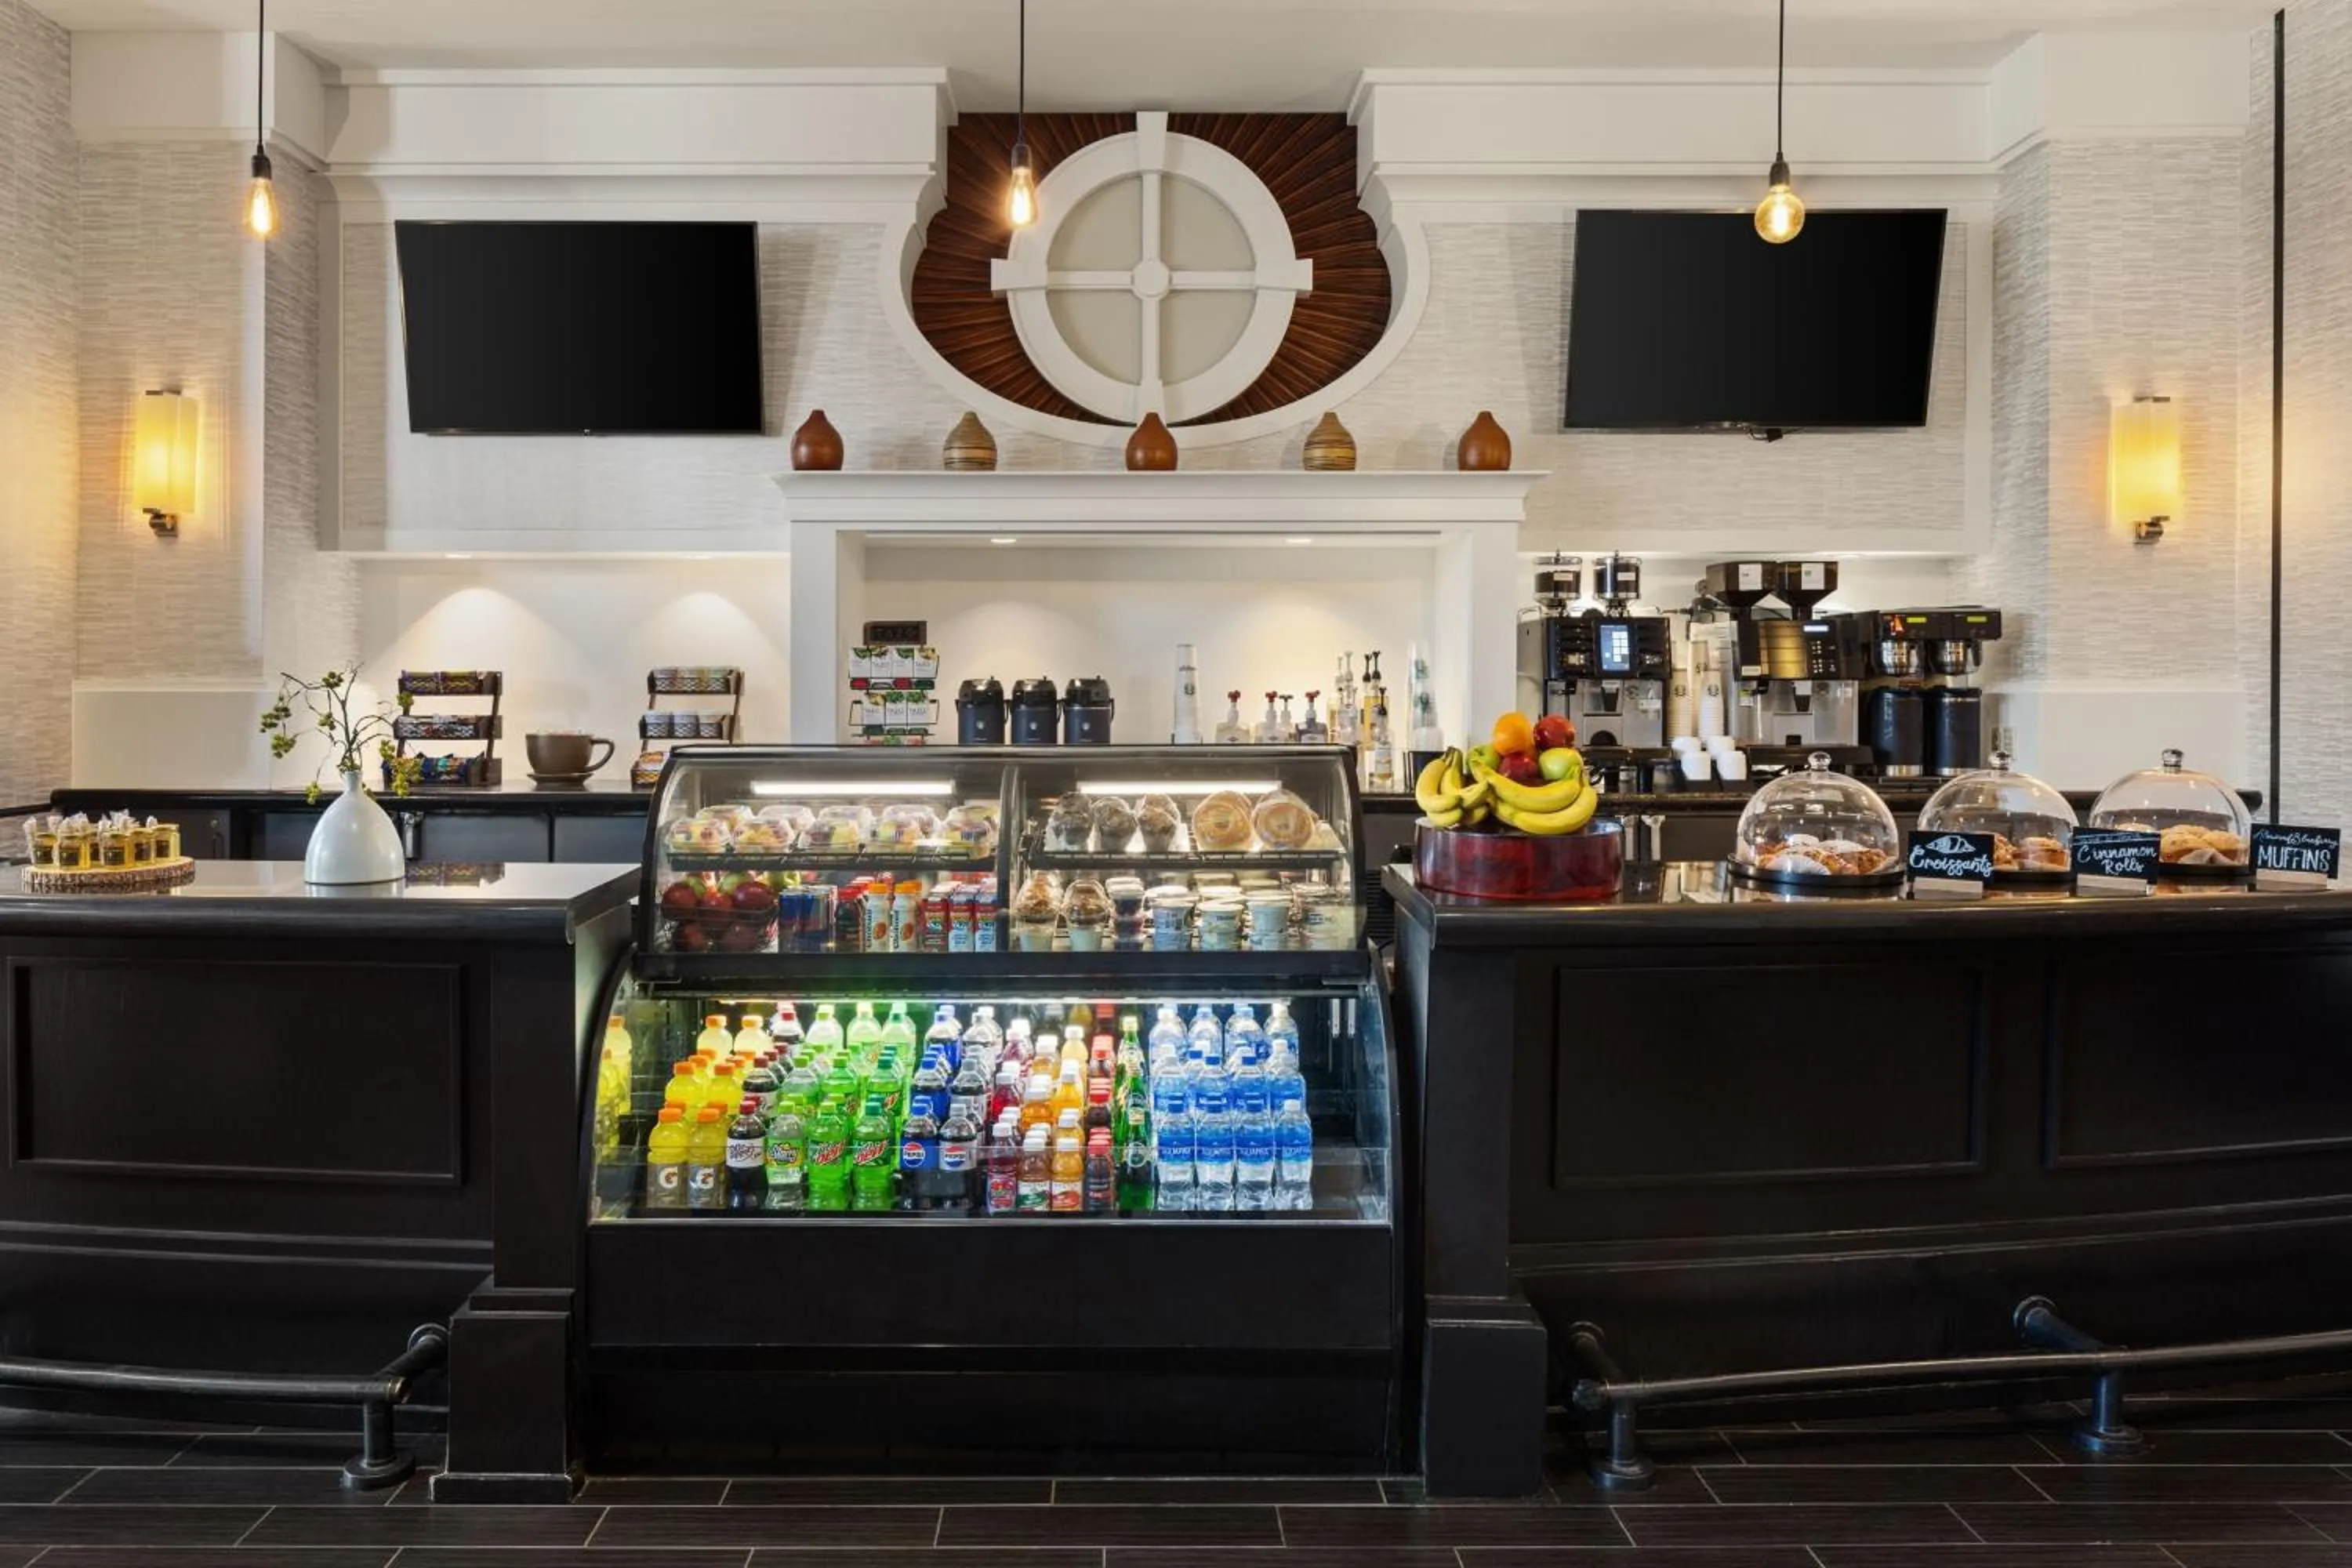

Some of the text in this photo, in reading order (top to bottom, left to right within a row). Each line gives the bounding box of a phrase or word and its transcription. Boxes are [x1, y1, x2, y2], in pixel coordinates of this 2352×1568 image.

[2077, 844, 2158, 863] Cinnamon
[2257, 844, 2332, 872] MUFFINS
[2100, 857, 2144, 875] Rolls
[659, 1167, 678, 1189] G
[697, 1167, 714, 1189] G
